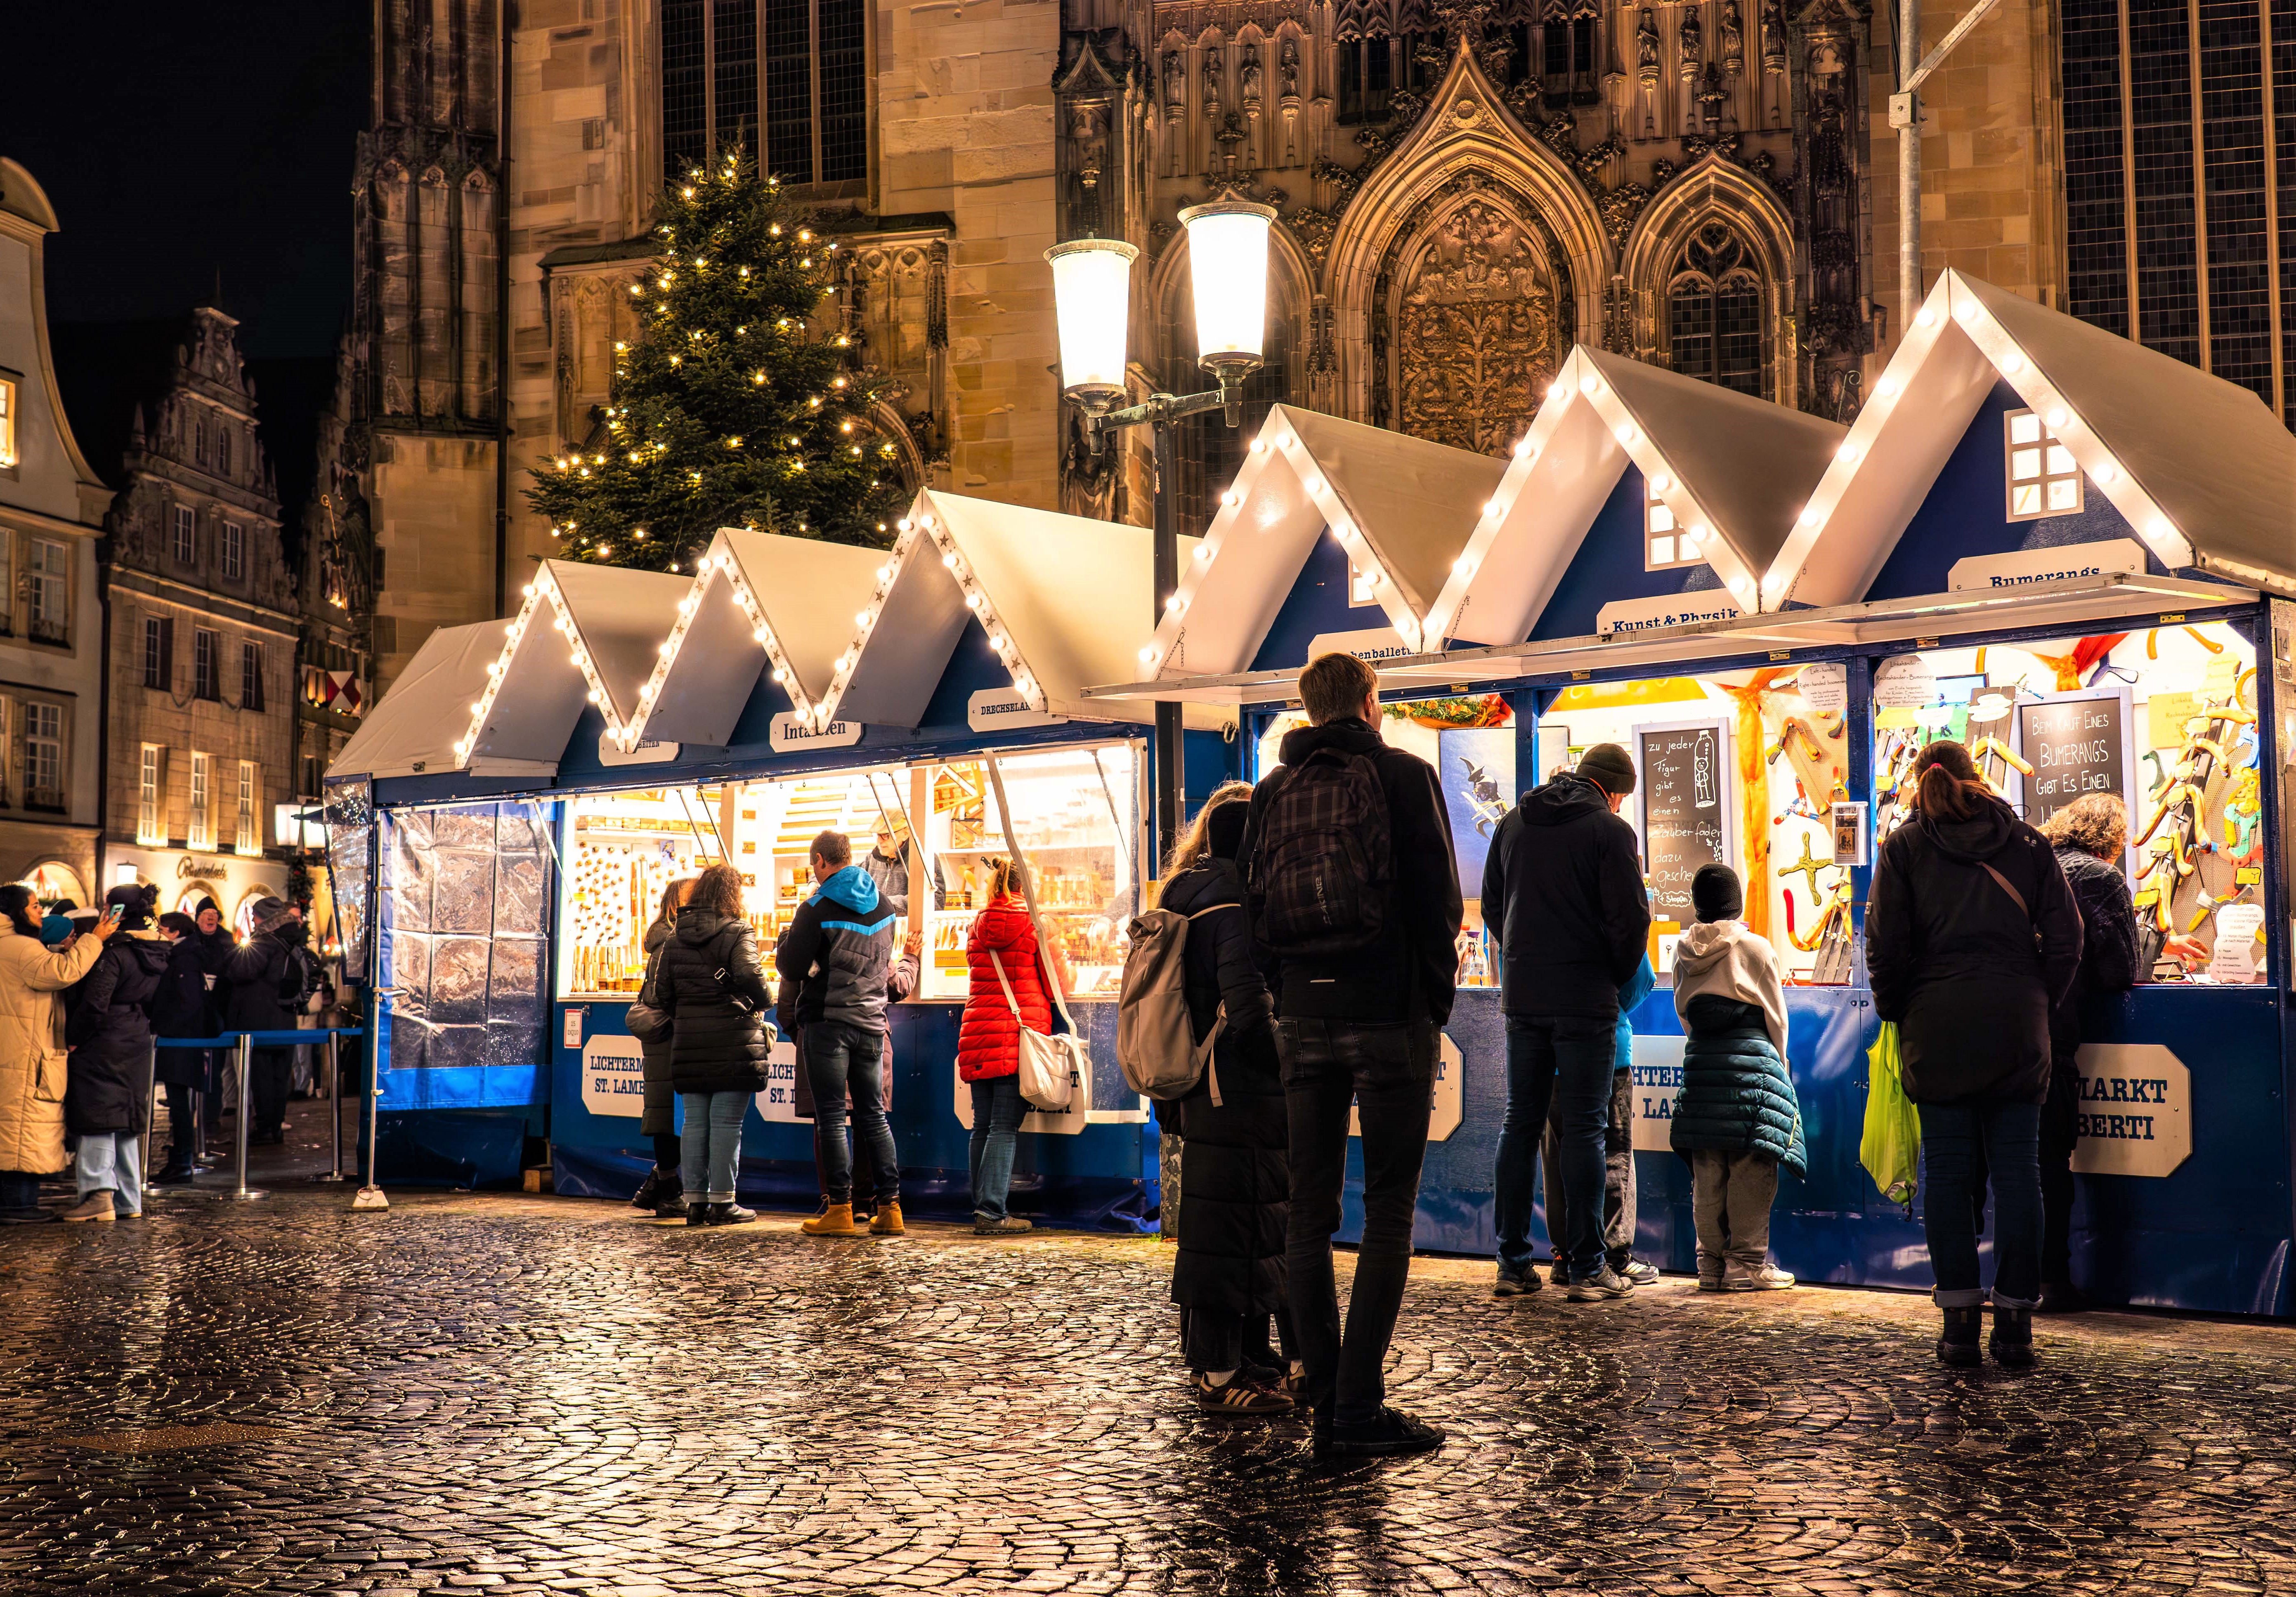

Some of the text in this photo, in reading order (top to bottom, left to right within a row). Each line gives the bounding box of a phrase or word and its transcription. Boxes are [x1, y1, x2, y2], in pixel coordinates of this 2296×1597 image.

[1215, 392, 1220, 403] 2
[1989, 567, 2100, 587] Bumerangs
[1612, 616, 1661, 632] Kunst
[1663, 615, 1676, 625] &
[1810, 666, 1837, 675] Left-handed
[1799, 680, 1826, 689] Right-handed
[1648, 736, 1694, 755] zu jeder
[2040, 739, 2109, 768] BUMERANGS
[1653, 758, 1680, 777] Figur
[1655, 781, 1674, 797] gibt
[1669, 795, 1682, 803] es
[1653, 806, 1679, 816] einen
[1654, 847, 1682, 863] dazu
[590, 1055, 643, 1072] LICHTERM
[595, 1078, 610, 1093] ST.
[770, 1087, 786, 1104] ST.
[1643, 1098, 1676, 1120] LA
